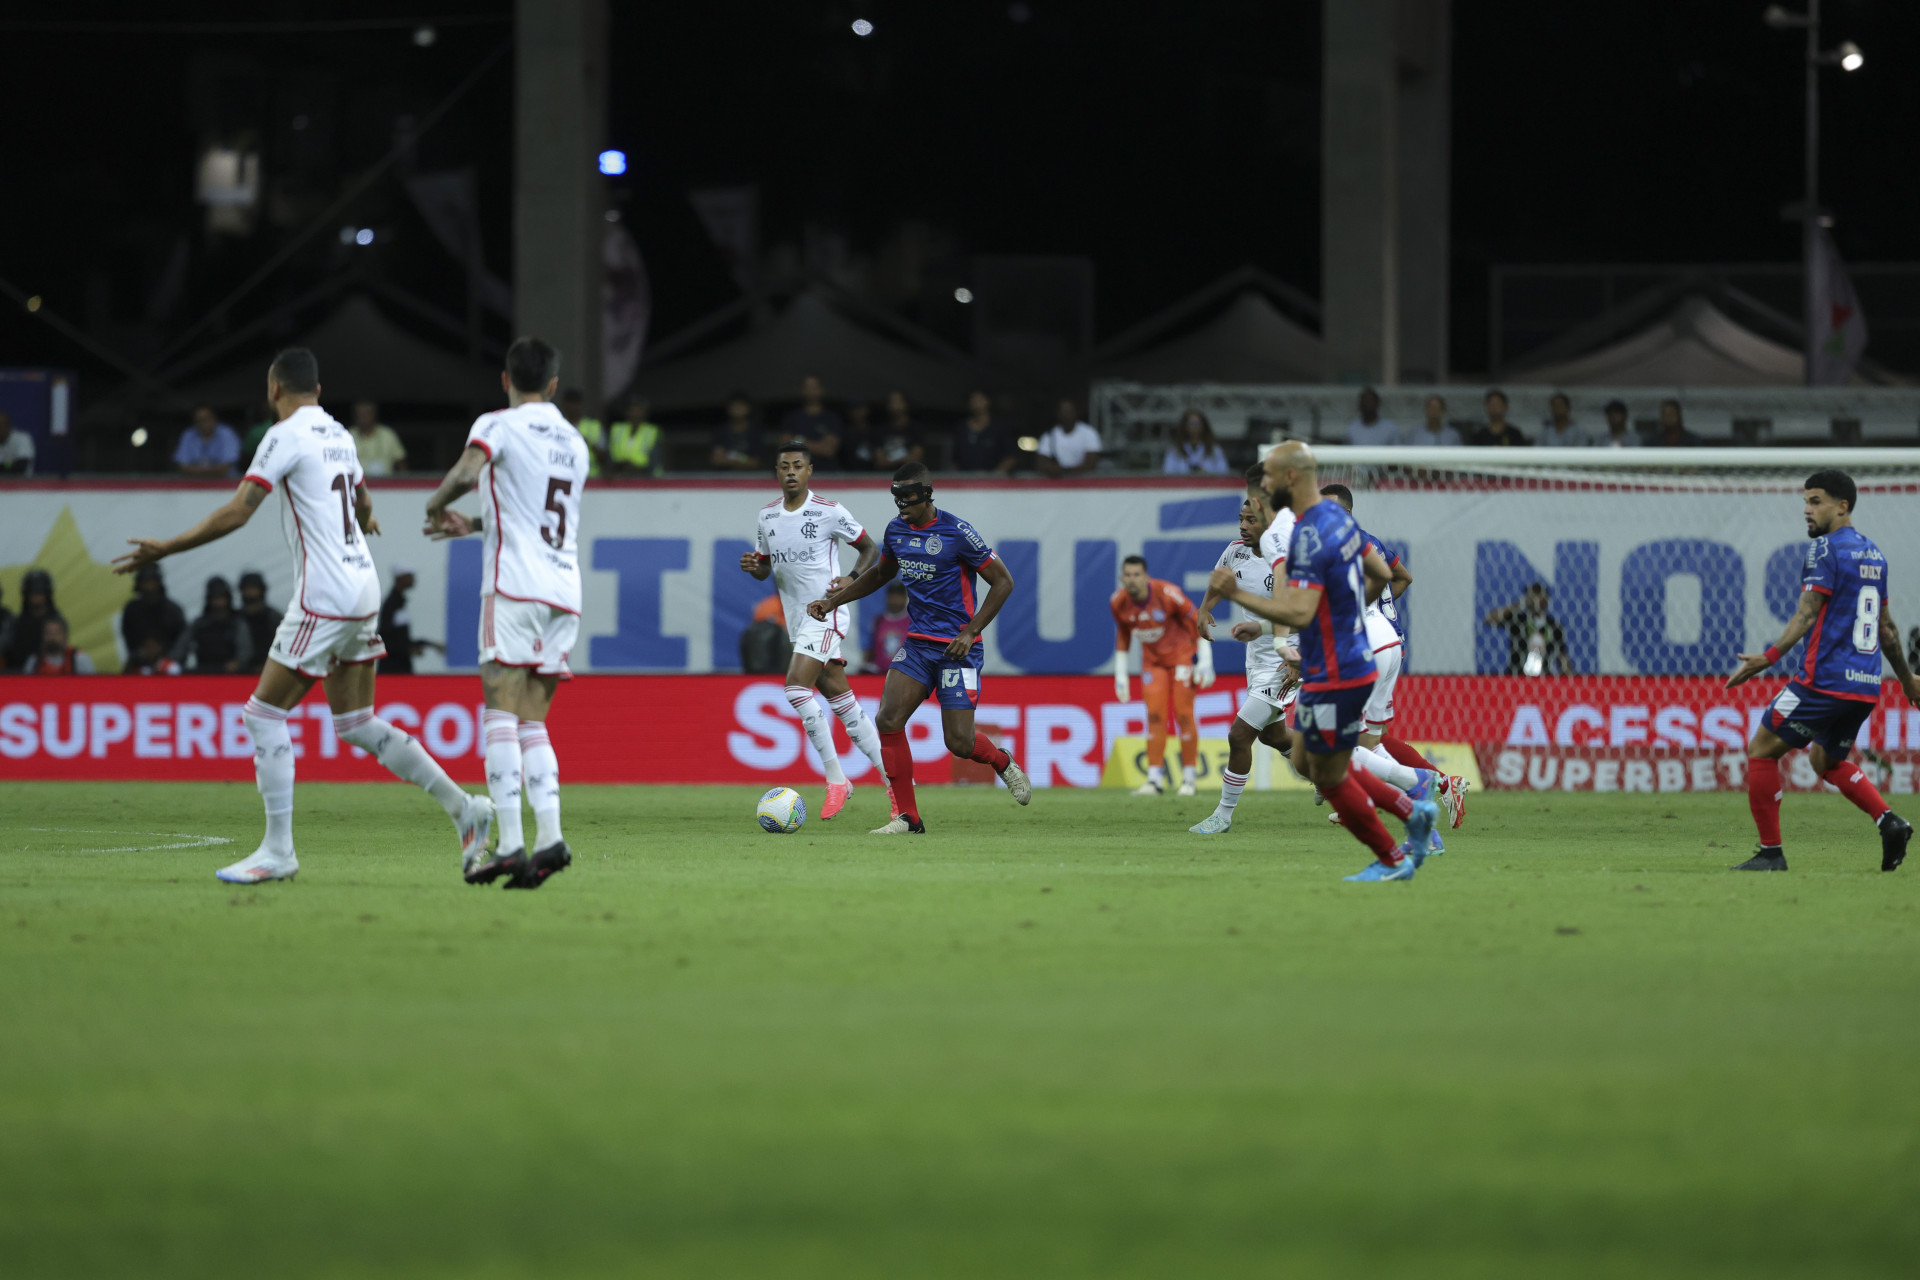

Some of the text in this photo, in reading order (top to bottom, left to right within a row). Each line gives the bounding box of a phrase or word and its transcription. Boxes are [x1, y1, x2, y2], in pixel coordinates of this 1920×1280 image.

[540, 477, 573, 550] 5
[771, 546, 817, 567] pixbet
[1852, 585, 1881, 655] 8
[0, 702, 487, 759] SUPERBET.CO
